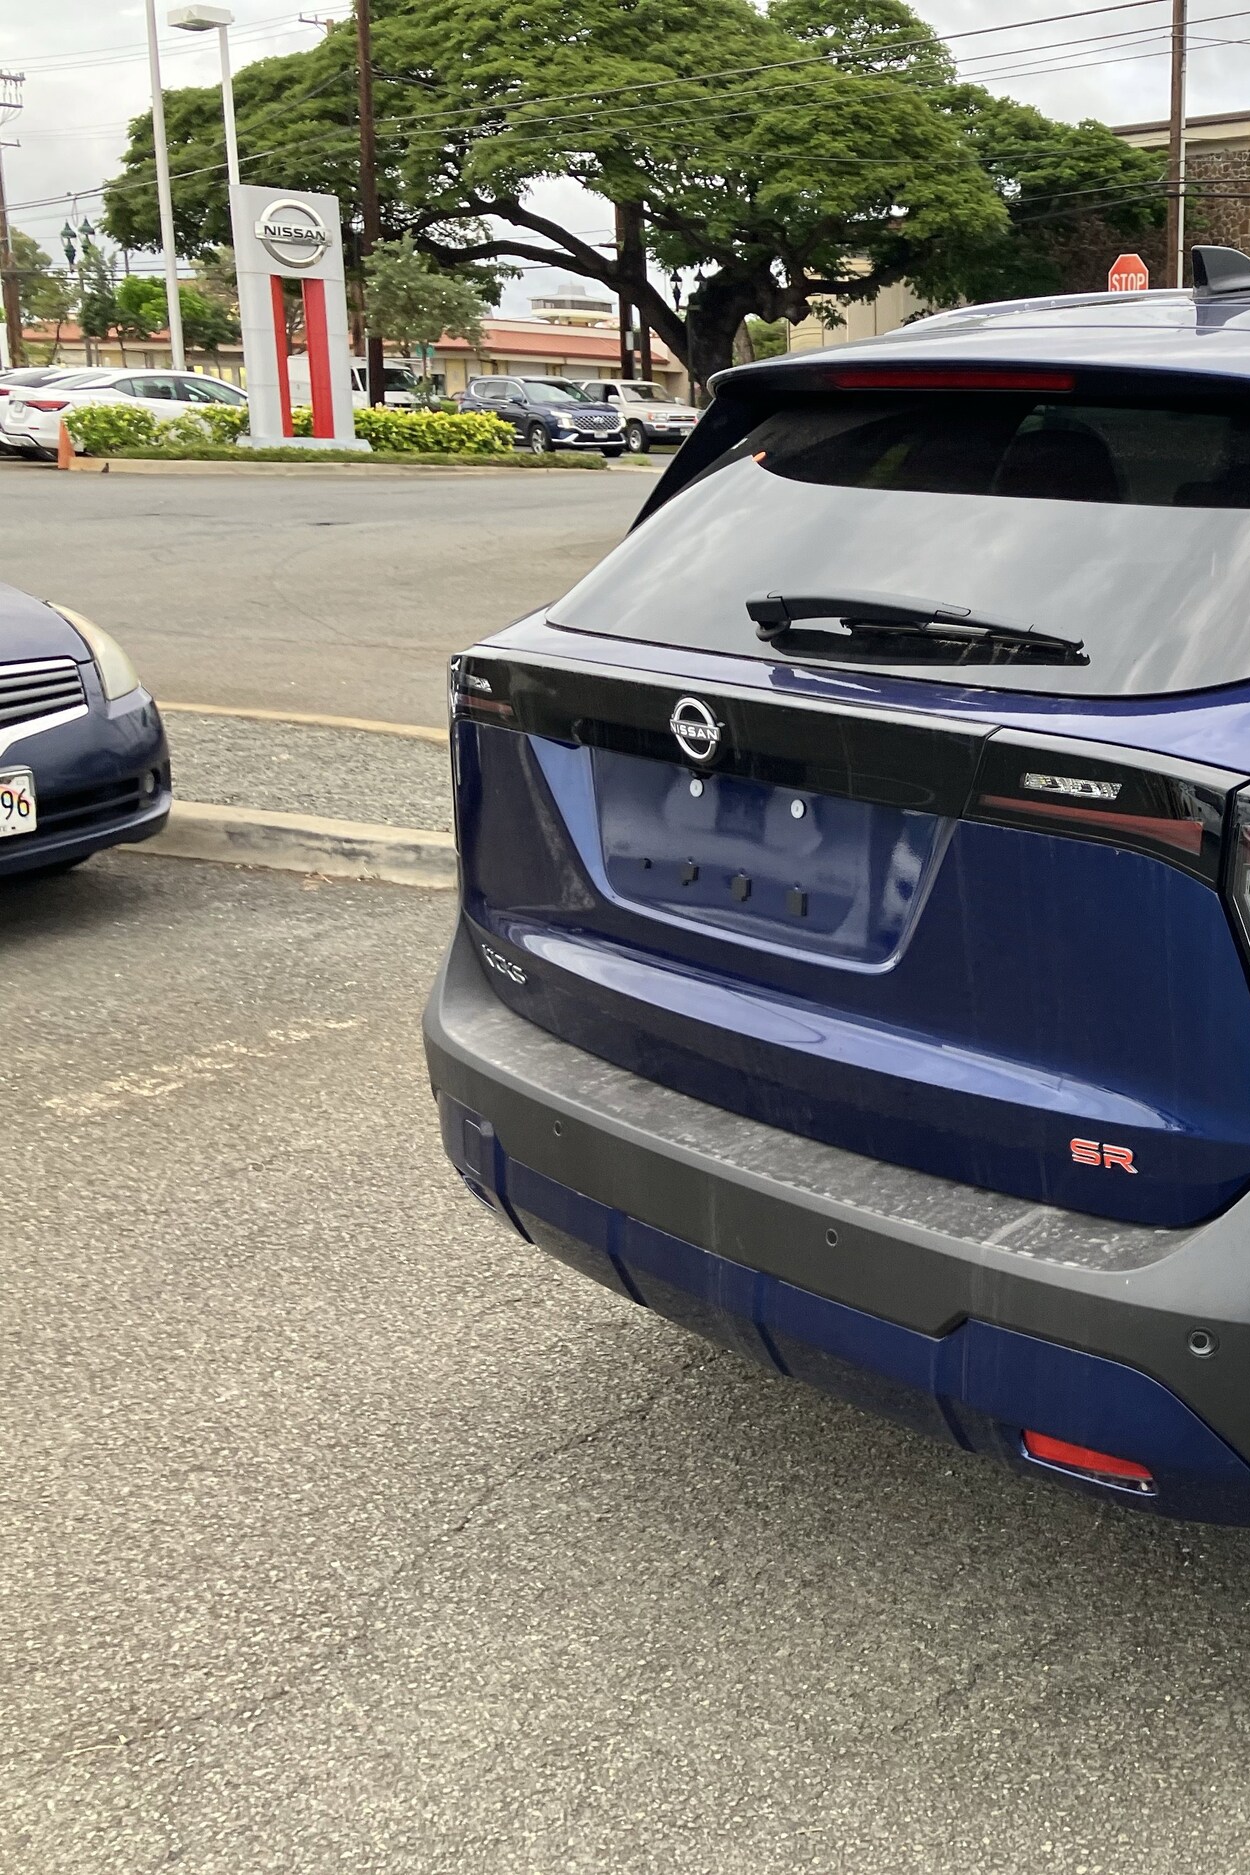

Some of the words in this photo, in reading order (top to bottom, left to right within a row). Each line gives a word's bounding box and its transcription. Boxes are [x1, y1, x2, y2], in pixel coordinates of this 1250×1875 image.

[264, 225, 326, 241] NISSAN
[1111, 273, 1146, 291] STOP
[670, 722, 718, 740] NISSAN
[1, 788, 30, 820] 96
[1070, 1138, 1138, 1173] SR
